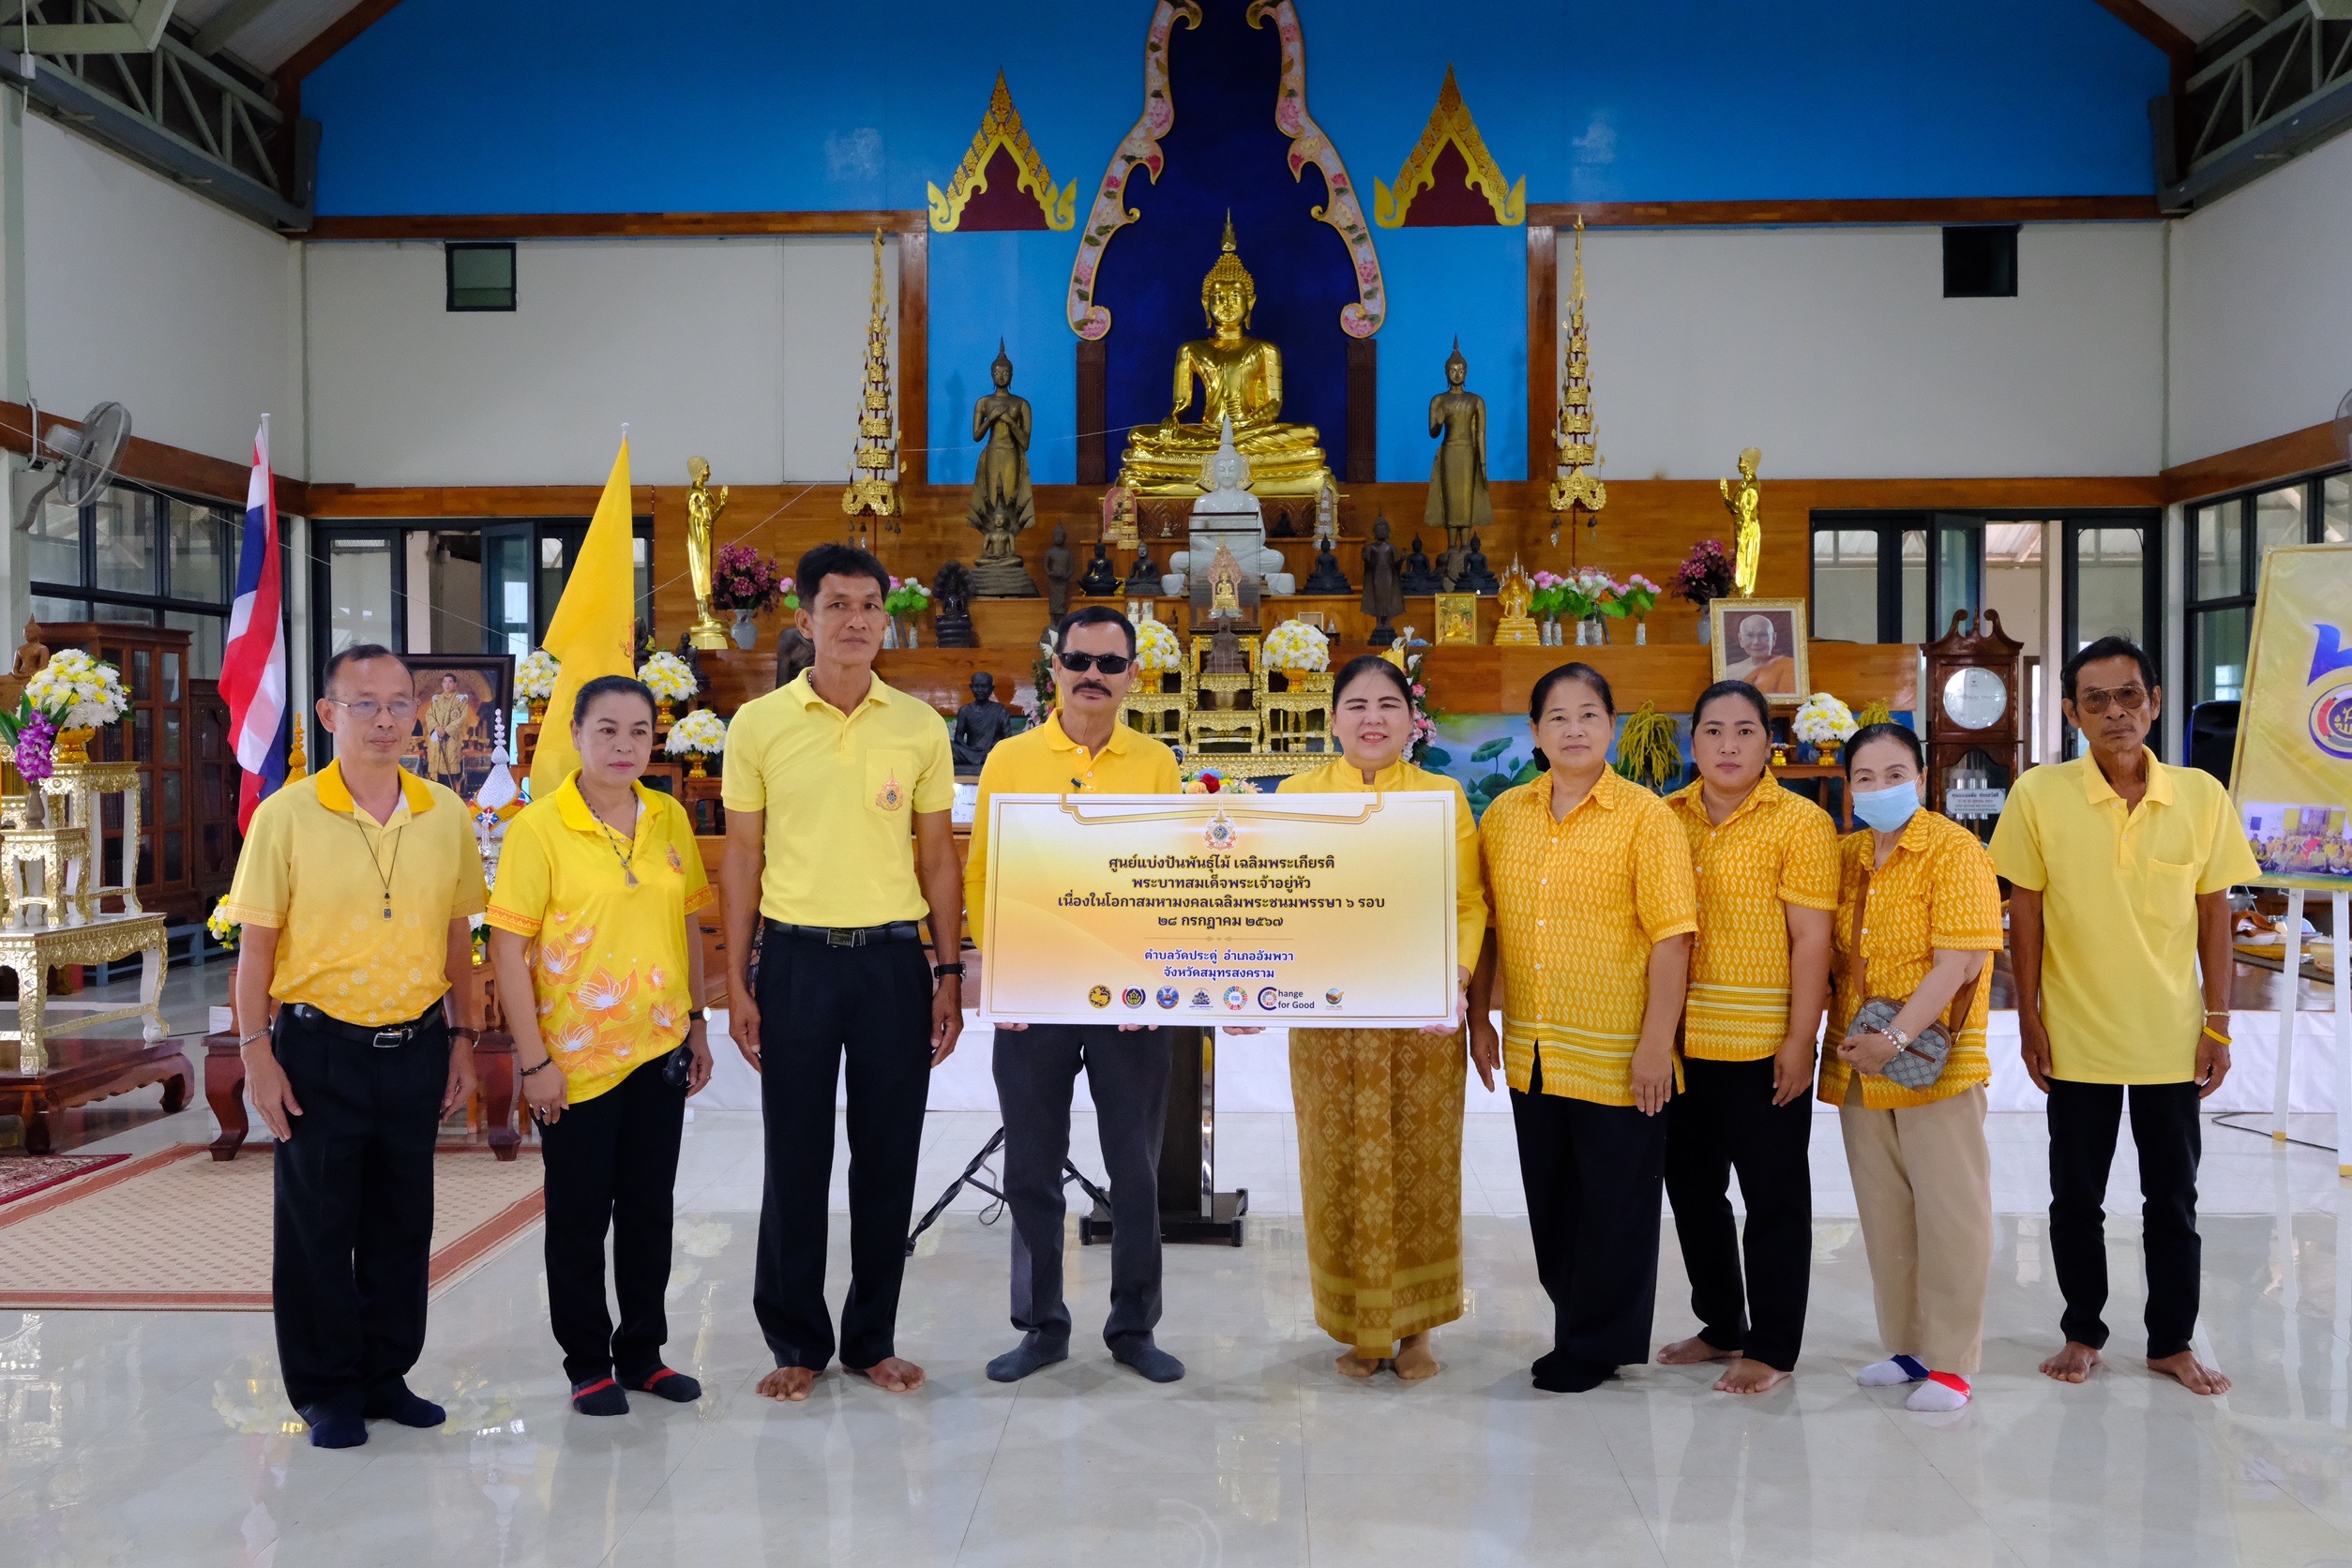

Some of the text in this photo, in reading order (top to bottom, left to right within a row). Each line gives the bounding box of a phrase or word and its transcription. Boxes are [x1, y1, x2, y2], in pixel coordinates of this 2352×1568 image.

[1108, 853, 1335, 873] ศูนย์แบ่งปันพันธุ์ไม้ เฉลิมพระเกียรติ
[1131, 874, 1311, 893] พระบาทสมเด็จพระเจ้าอยู่หัว
[1058, 890, 1386, 909] เนื่องในโอกาสมหามงคลเฉลิมพระชนมพรรษา ๖ รอบ
[1157, 915, 1284, 929] ๒๘ กรกฎาคม ๒๕๖๗
[1144, 948, 1294, 964] ตำบลวัดประดู่ อำเภออัมพวา
[1163, 965, 1275, 981] จังหวัดสมุทรสงคราม
[1277, 1001, 1315, 1009] for Good
